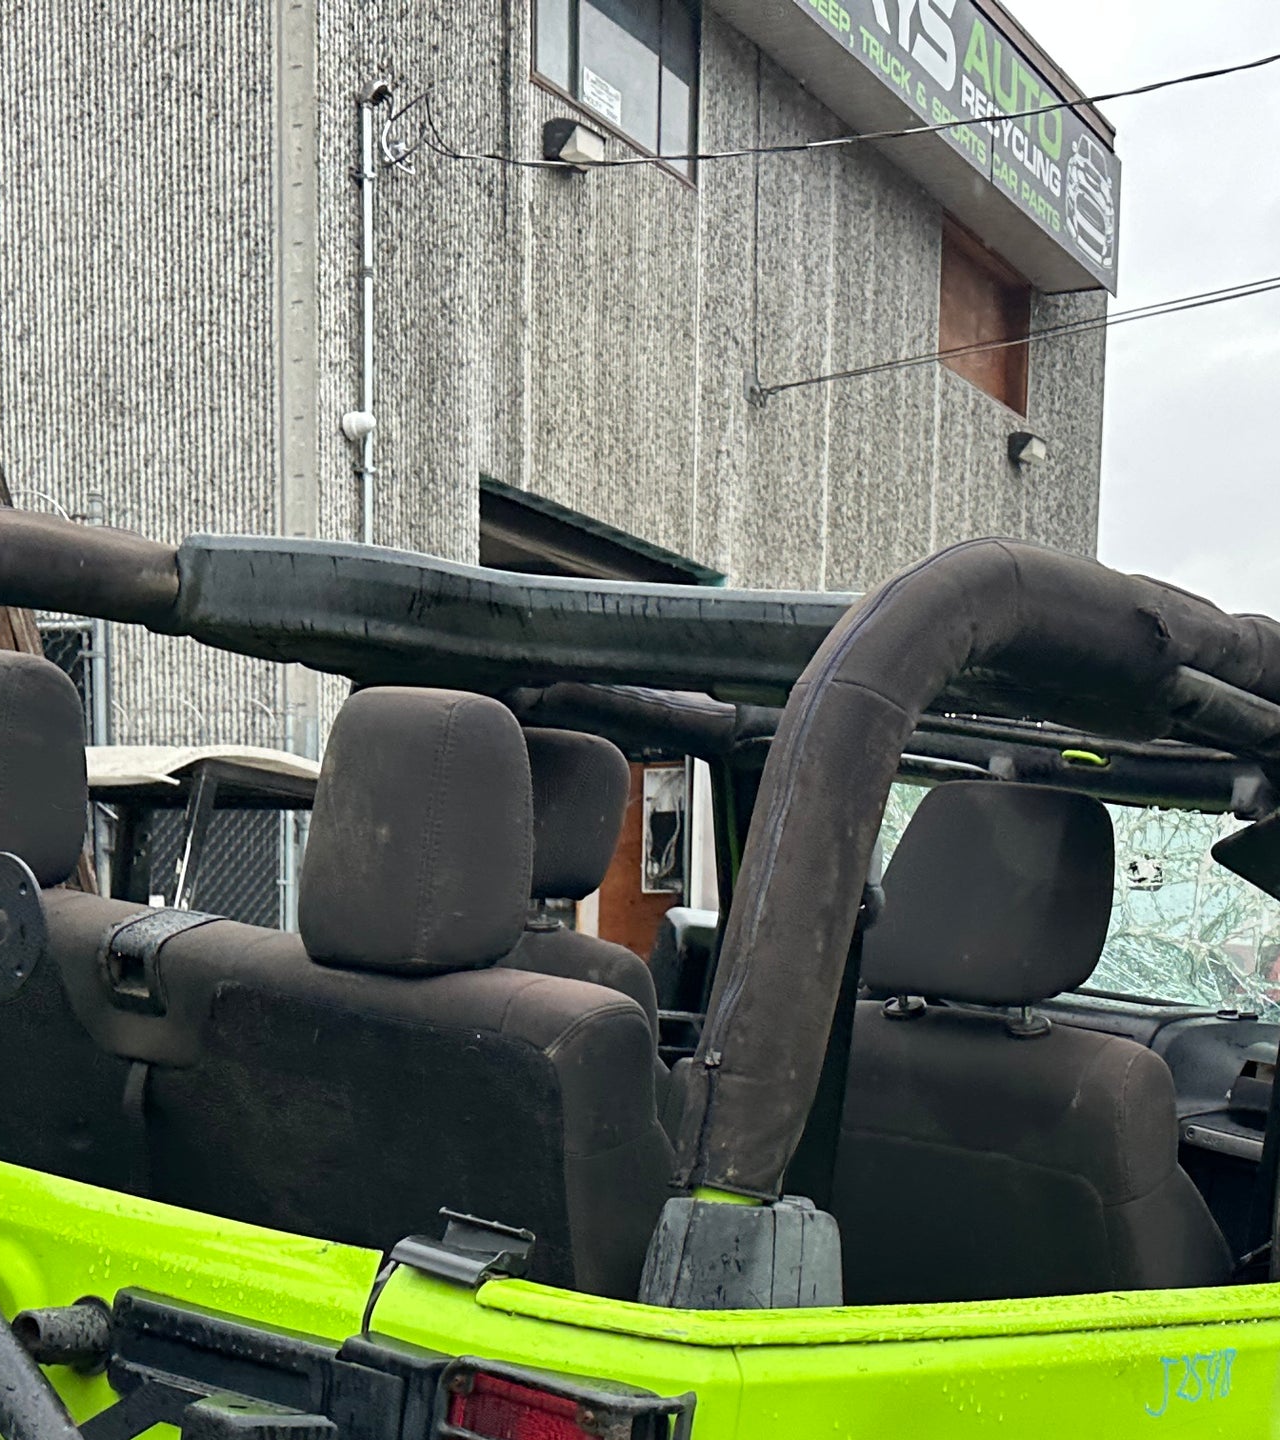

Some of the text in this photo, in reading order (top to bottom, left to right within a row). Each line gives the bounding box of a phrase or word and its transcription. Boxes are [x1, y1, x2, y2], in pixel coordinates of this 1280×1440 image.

[859, 25, 912, 96] TRUCK
[915, 80, 928, 110] &
[931, 97, 987, 167] SPORTS
[991, 154, 1019, 197] CAR
[1020, 180, 1061, 234] PARTS
[961, 74, 1062, 198] RECYCLING
[963, 17, 1063, 162] AUTO
